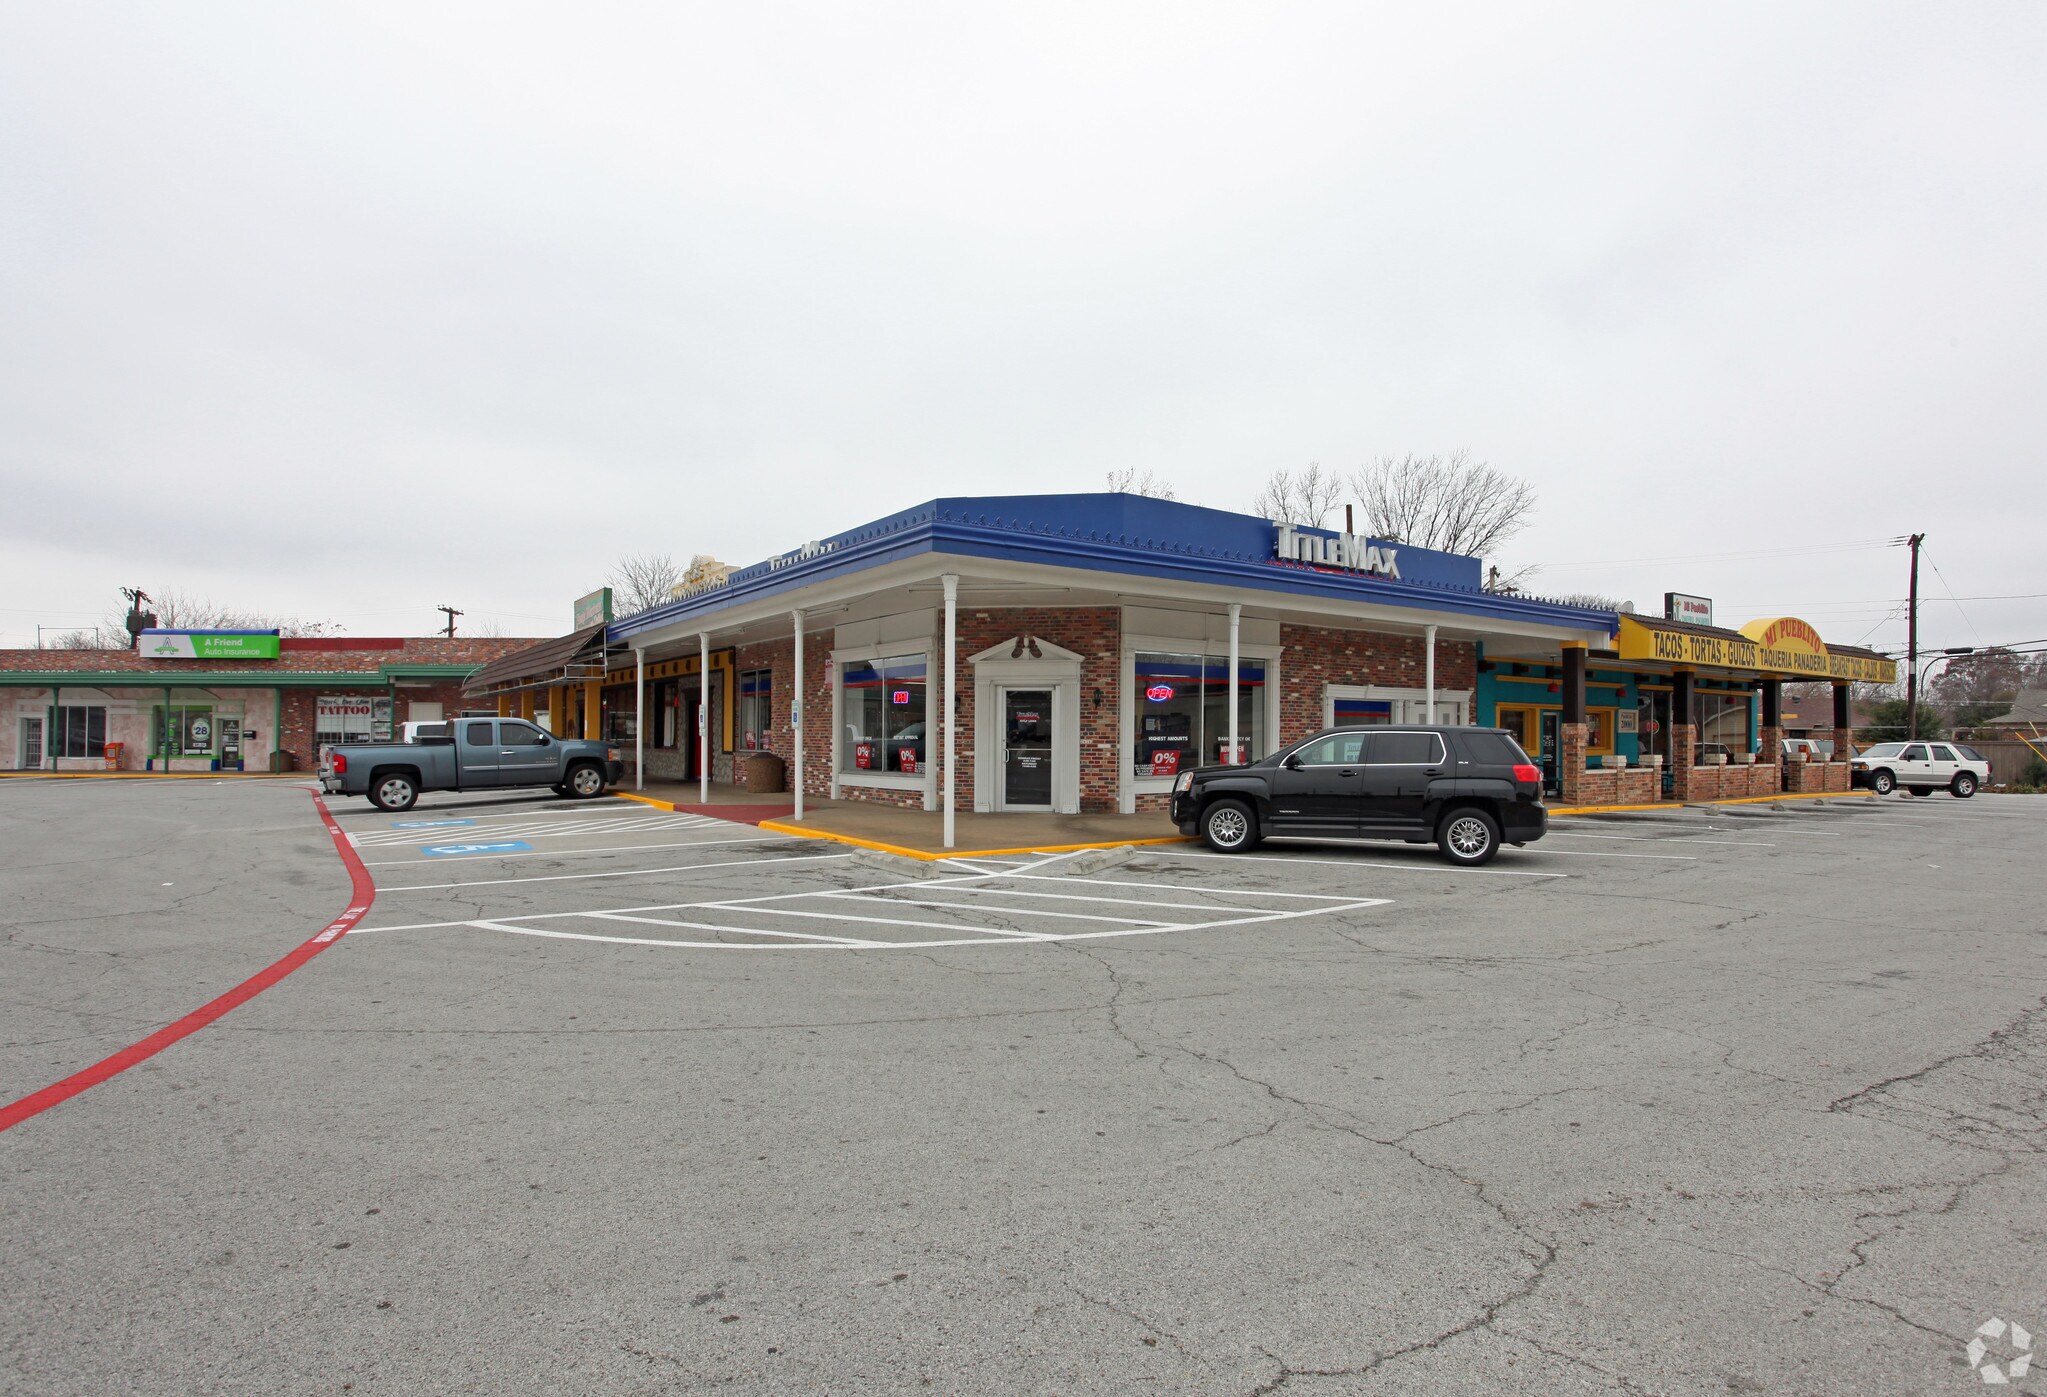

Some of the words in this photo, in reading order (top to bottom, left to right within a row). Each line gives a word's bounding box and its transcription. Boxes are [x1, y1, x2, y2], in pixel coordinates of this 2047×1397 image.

[1764, 624, 1778, 650] MI
[1780, 618, 1821, 654] PUEBLITO
[204, 638, 212, 646] A
[213, 638, 243, 646] Friend
[204, 648, 221, 656] Auto
[223, 648, 260, 656] Insurance
[1653, 632, 1683, 659] TACOS
[1690, 636, 1722, 664] TORTAS
[1727, 641, 1756, 667] GUIZOS
[1760, 648, 1792, 669] TAQUERIA
[1793, 652, 1827, 672] PANADERIA
[1146, 688, 1173, 698] OPEN
[317, 705, 370, 715] TATTOO
[857, 746, 869, 758] 0%
[901, 750, 914, 761] 0%
[1154, 752, 1176, 764] 0%
